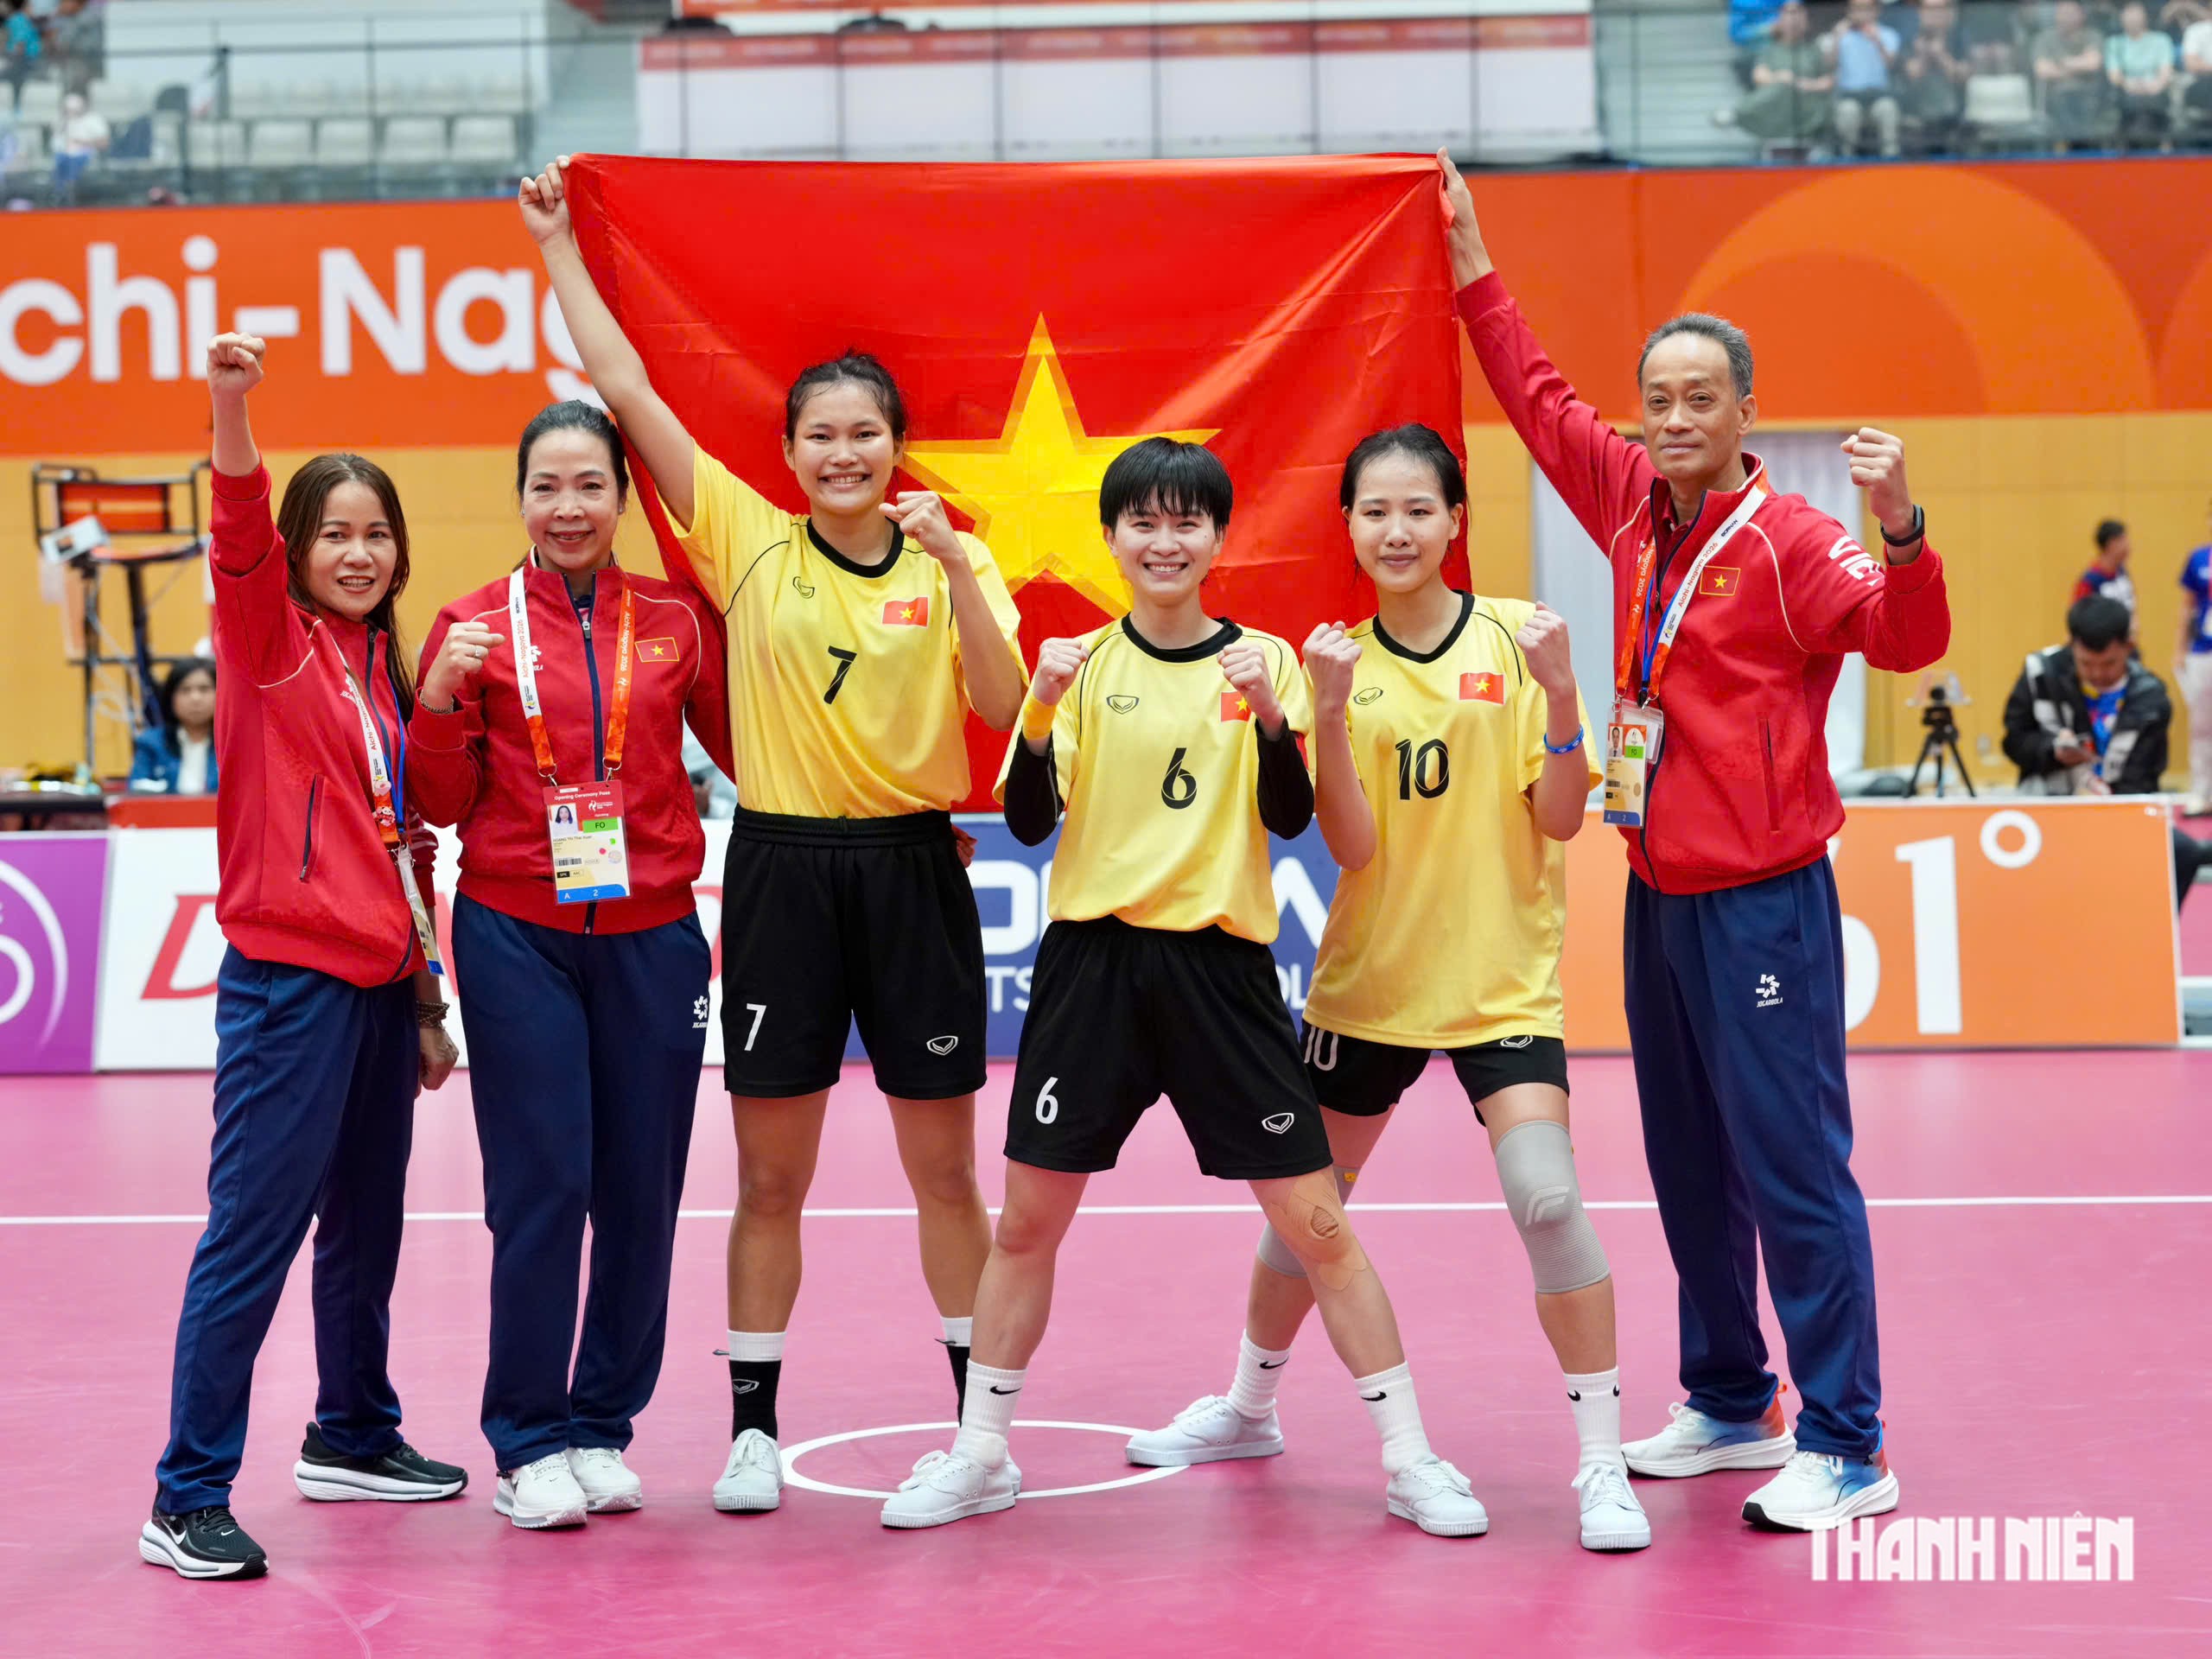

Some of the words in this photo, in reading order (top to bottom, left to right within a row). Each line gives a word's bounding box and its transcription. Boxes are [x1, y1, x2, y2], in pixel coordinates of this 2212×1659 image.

[1677, 557, 1705, 608] Aichi-Nagoya
[1702, 542, 1719, 559] 2026
[620, 611, 631, 655] Aichi-Nagoya
[620, 654, 628, 672] 2026
[823, 645, 857, 705] 7
[1160, 747, 1198, 810] 6
[1395, 738, 1450, 801] 10
[744, 1002, 767, 1052] 7
[1303, 1025, 1339, 1071] 10
[1034, 1076, 1060, 1125] 6
